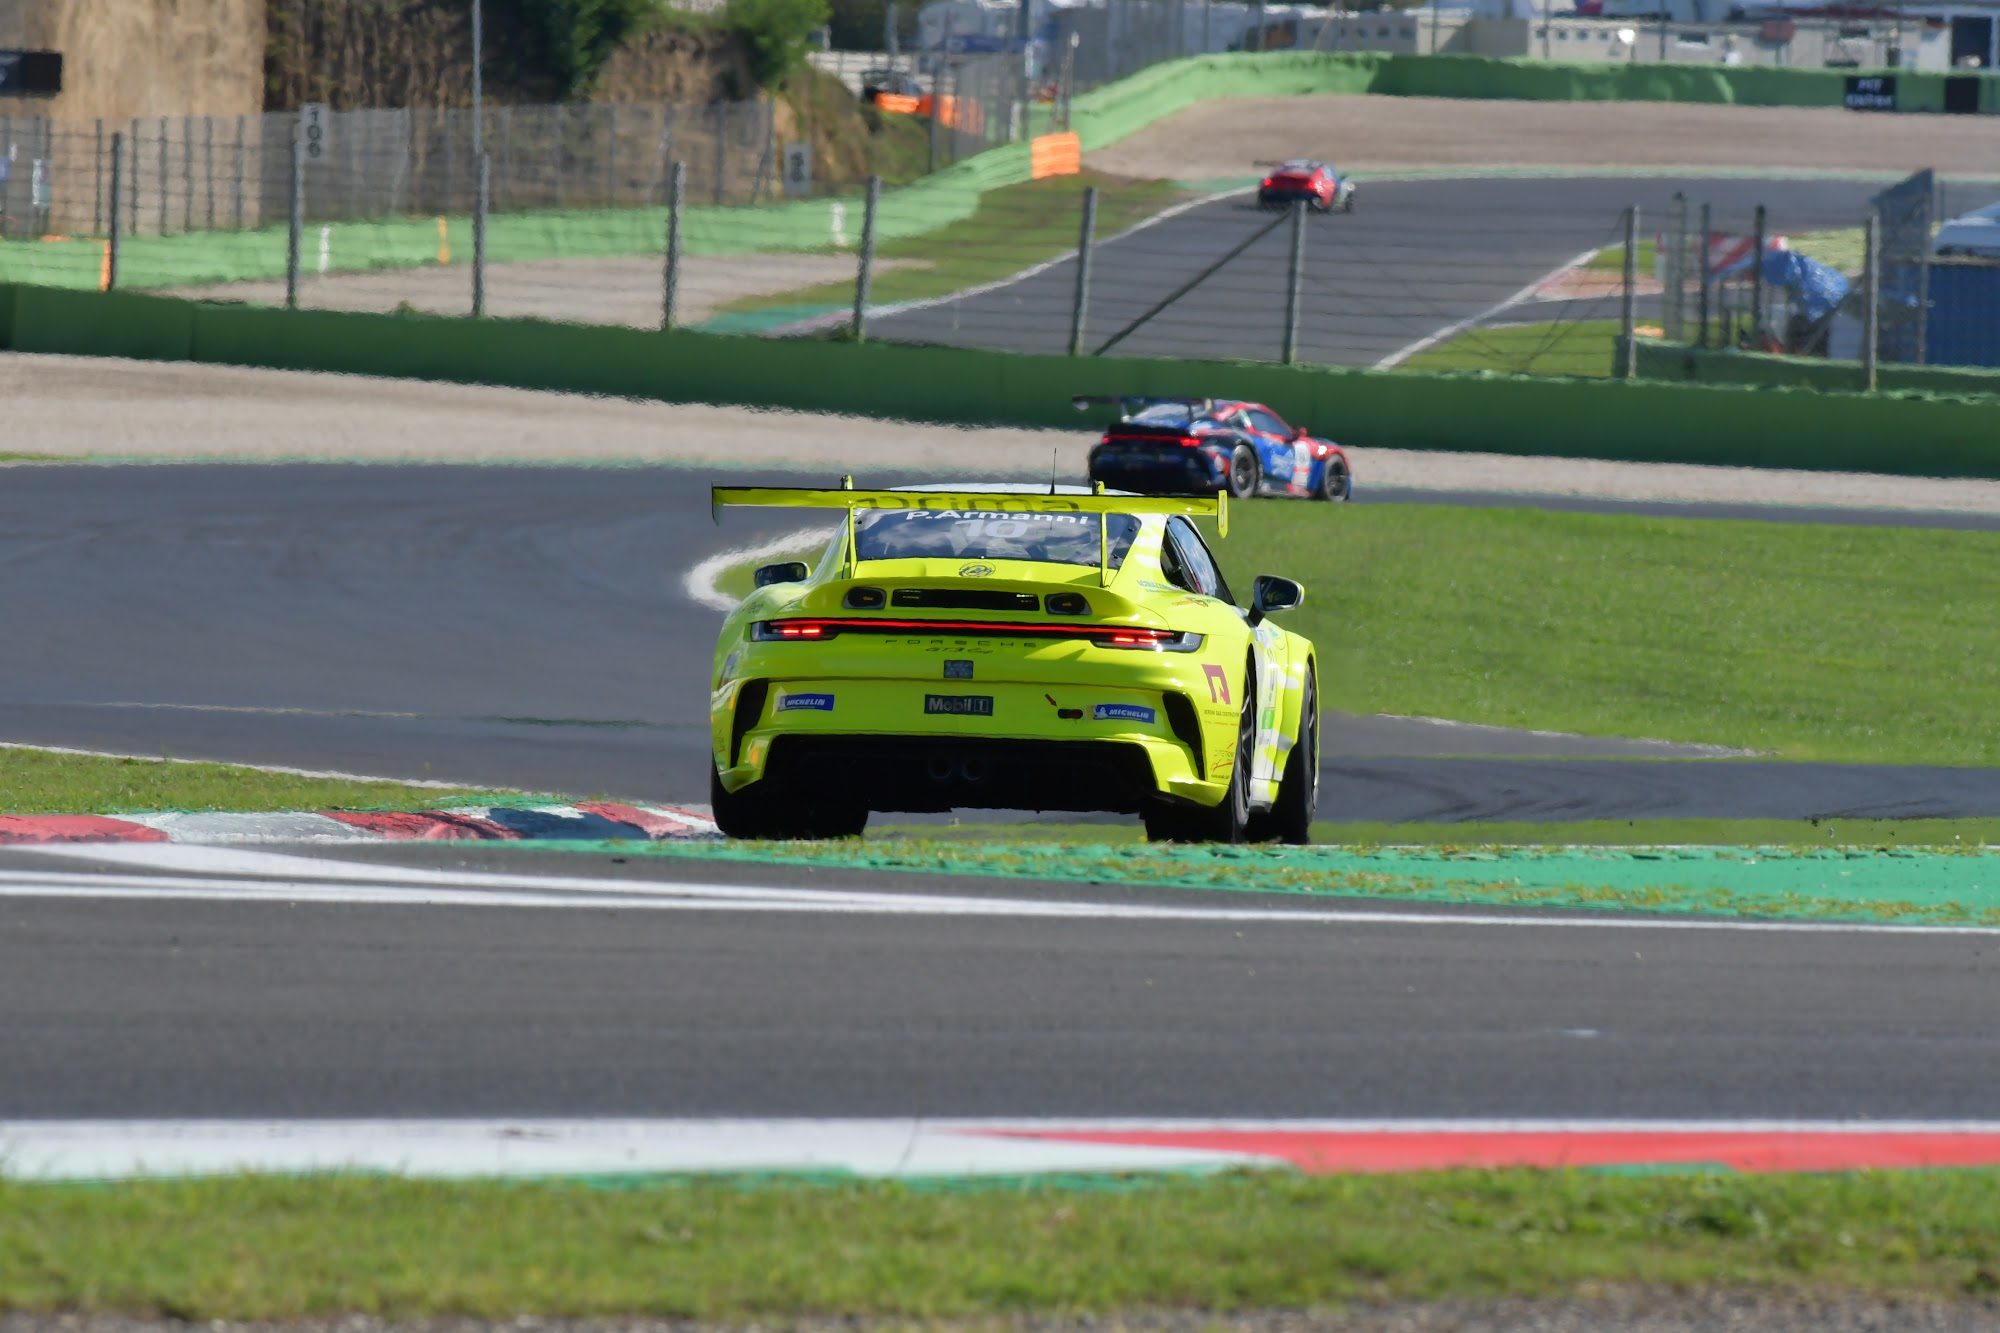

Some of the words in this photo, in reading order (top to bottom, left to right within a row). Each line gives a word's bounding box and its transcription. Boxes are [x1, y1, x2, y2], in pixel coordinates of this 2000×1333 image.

[954, 519, 1028, 538] 10
[786, 698, 826, 706] MICHELIN
[928, 697, 973, 712] Mobil
[1108, 708, 1150, 719] MICHELIN
